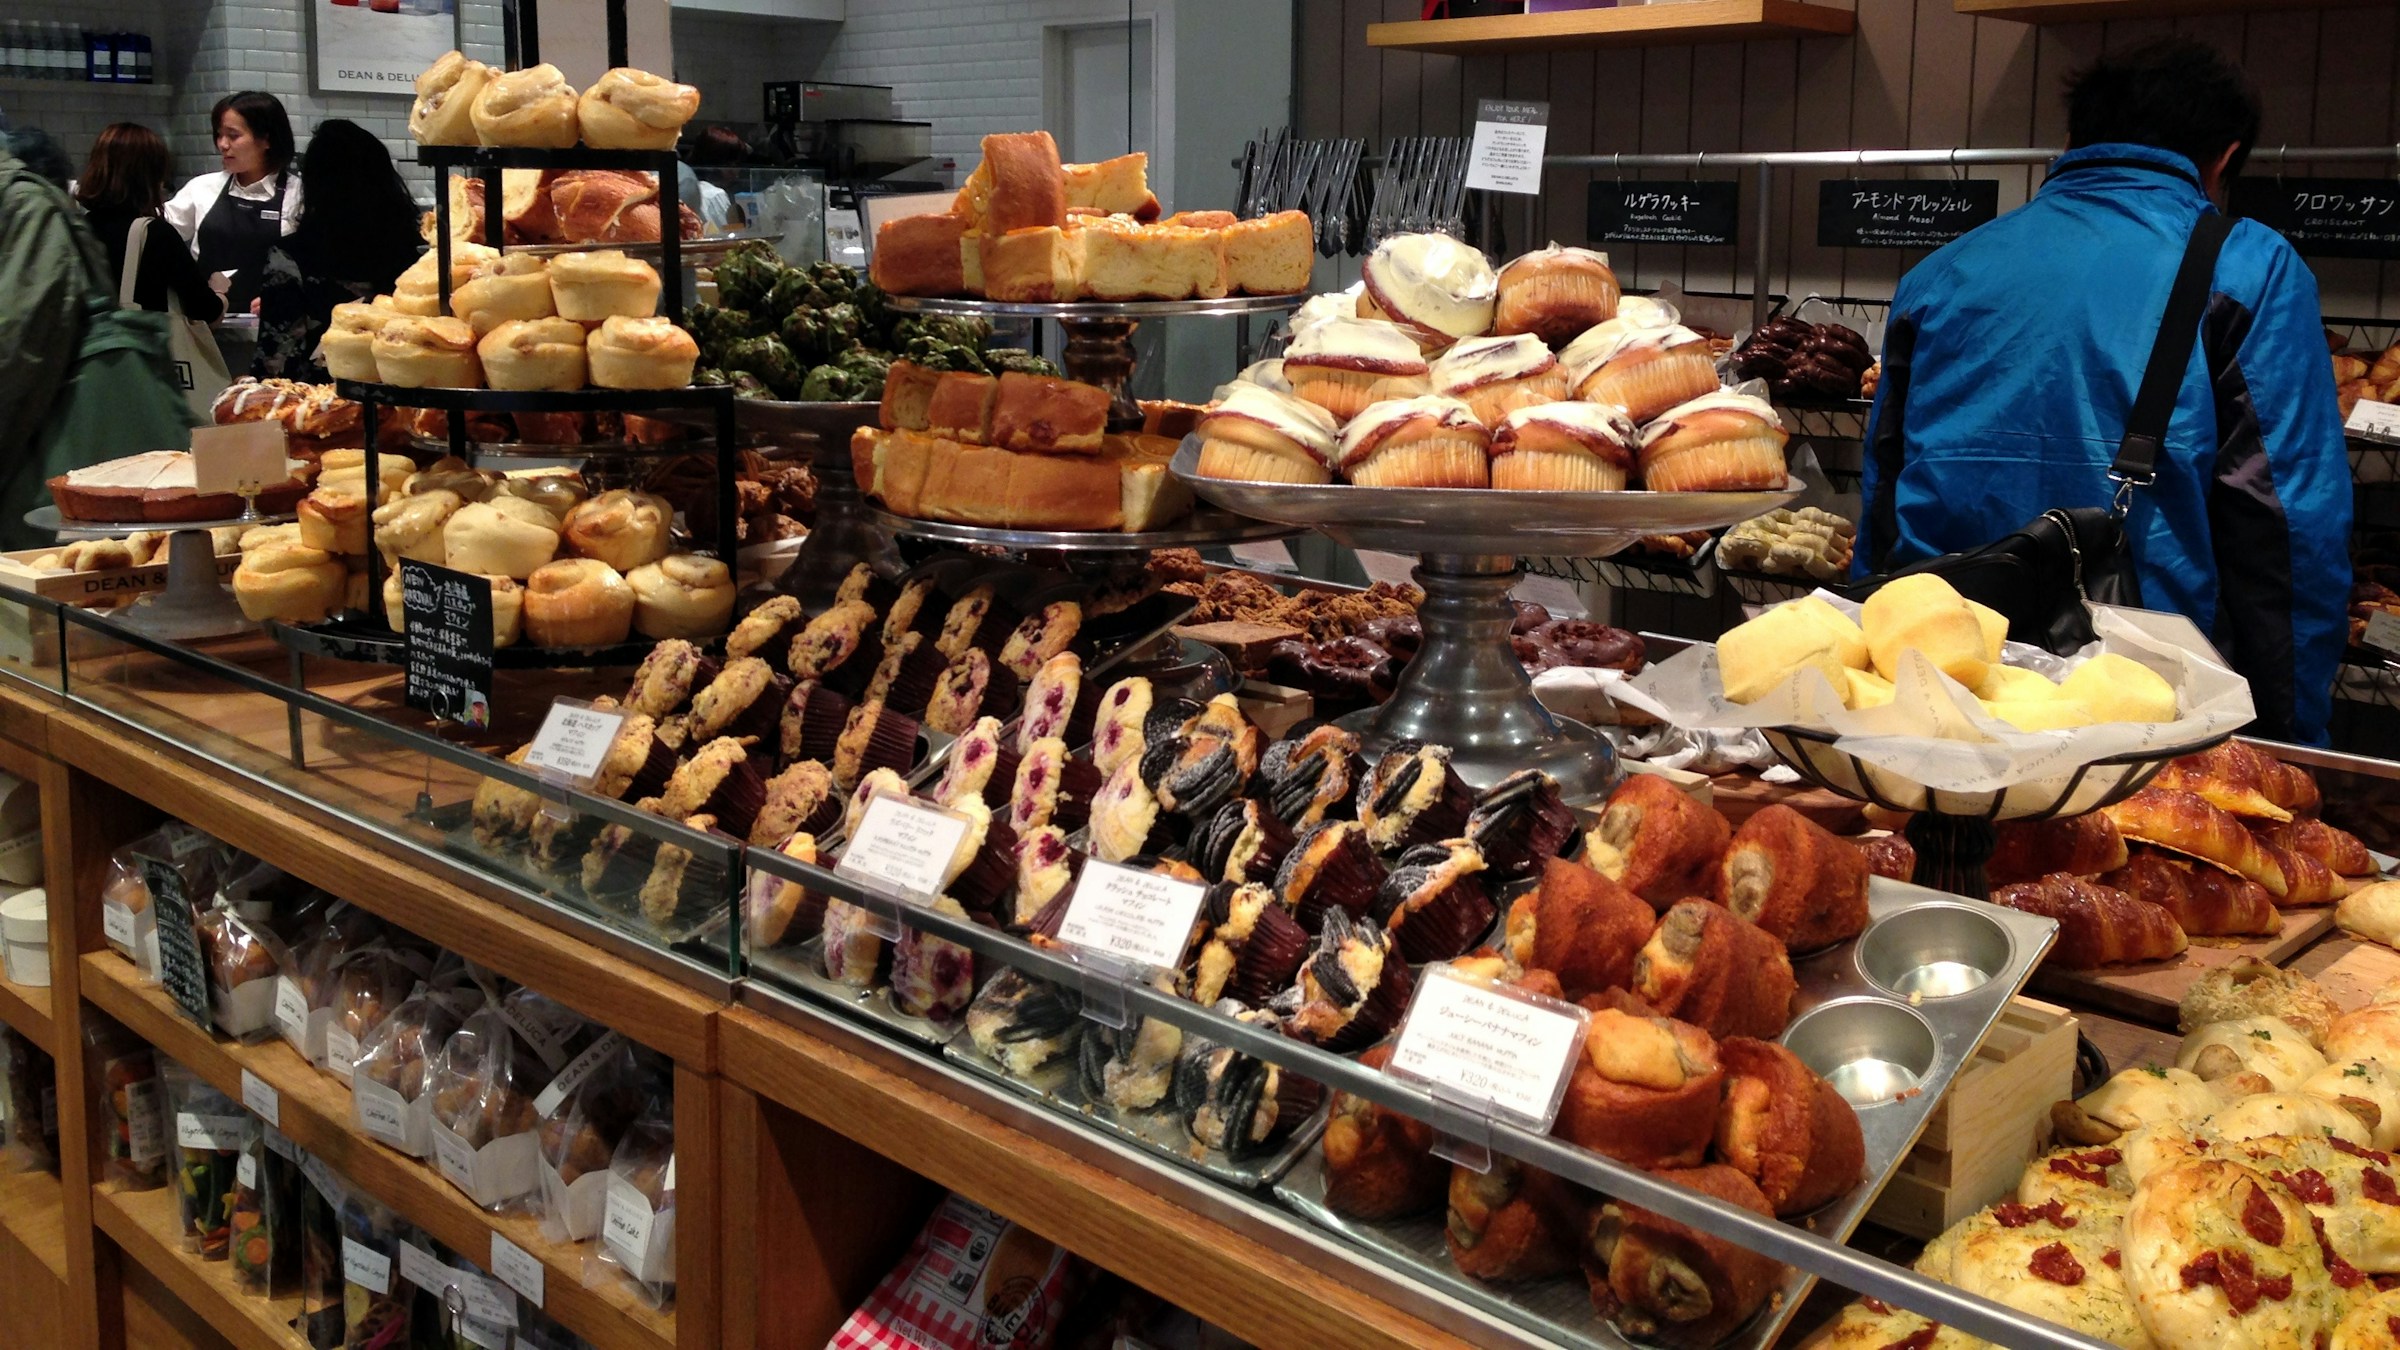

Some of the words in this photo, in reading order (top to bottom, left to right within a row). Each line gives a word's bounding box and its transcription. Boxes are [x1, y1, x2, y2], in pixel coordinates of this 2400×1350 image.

[338, 70, 372, 80] DEAN
[376, 72, 385, 81] &
[388, 73, 420, 82] DELU
[1624, 192, 1700, 212] ルゲラクッキー
[1852, 191, 1905, 211] アーモンド
[2294, 192, 2395, 216] クロワッサン
[85, 575, 146, 593] DEAN
[153, 572, 168, 585] &
[405, 573, 425, 587] NEW
[404, 588, 434, 607] ARRIVAL
[1110, 934, 1132, 950] ¥320
[507, 1006, 546, 1047] DELUCA
[1440, 1006, 1542, 1047] ジューシーバナナマフィン
[557, 1060, 590, 1092] DEAN
[1461, 1068, 1488, 1089] ¥320
[895, 1319, 912, 1338] Net
